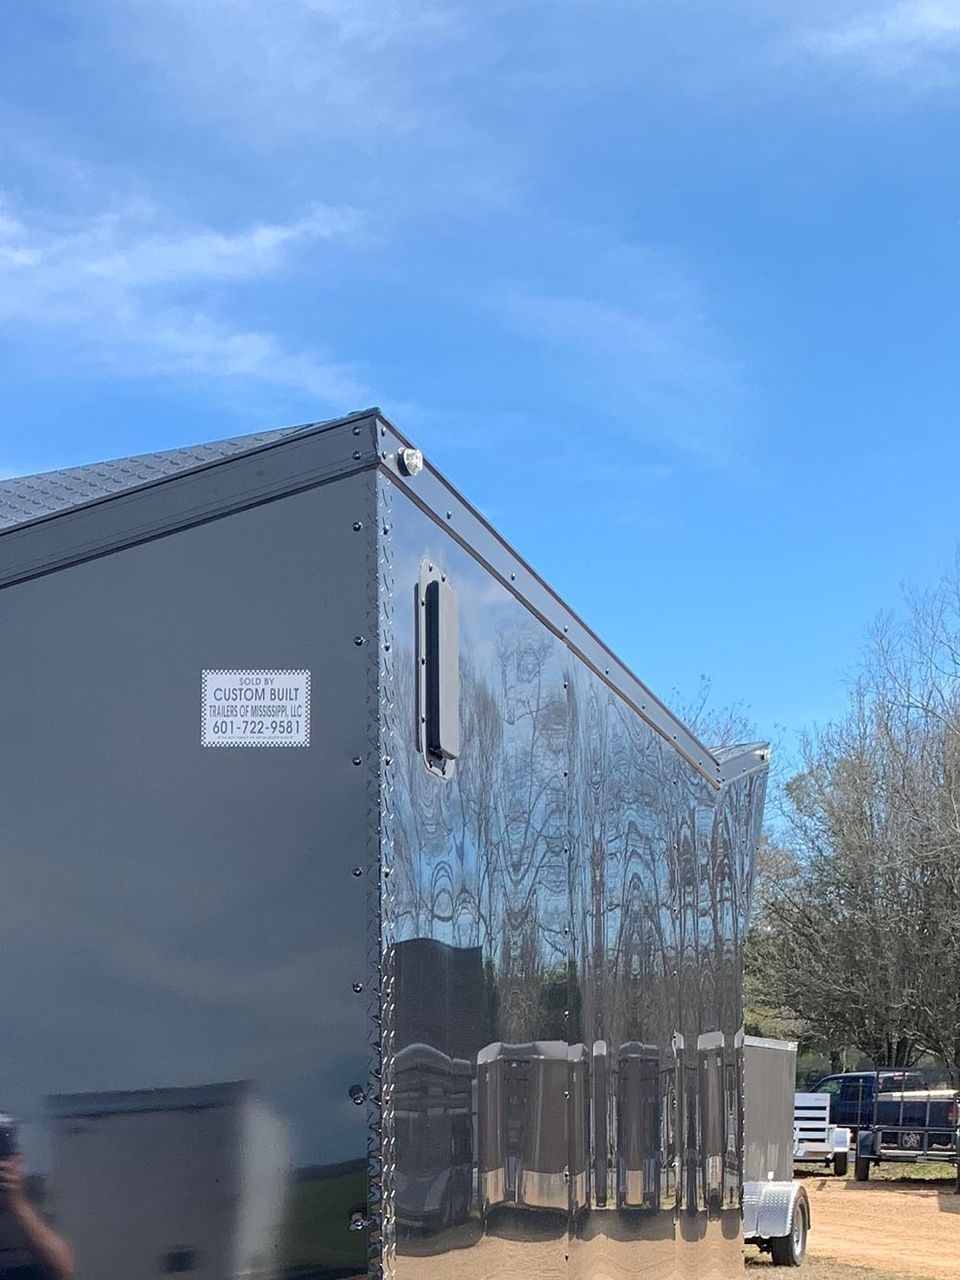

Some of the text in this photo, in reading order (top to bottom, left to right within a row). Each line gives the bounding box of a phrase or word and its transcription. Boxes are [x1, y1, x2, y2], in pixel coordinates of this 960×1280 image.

[239, 677, 275, 686] SOLD BY
[213, 687, 300, 702] CUSTOM BUILT
[209, 705, 238, 718] TRAILERS
[240, 705, 250, 718] OF
[290, 705, 303, 718] LLC
[212, 720, 300, 735] 601-722-9581
